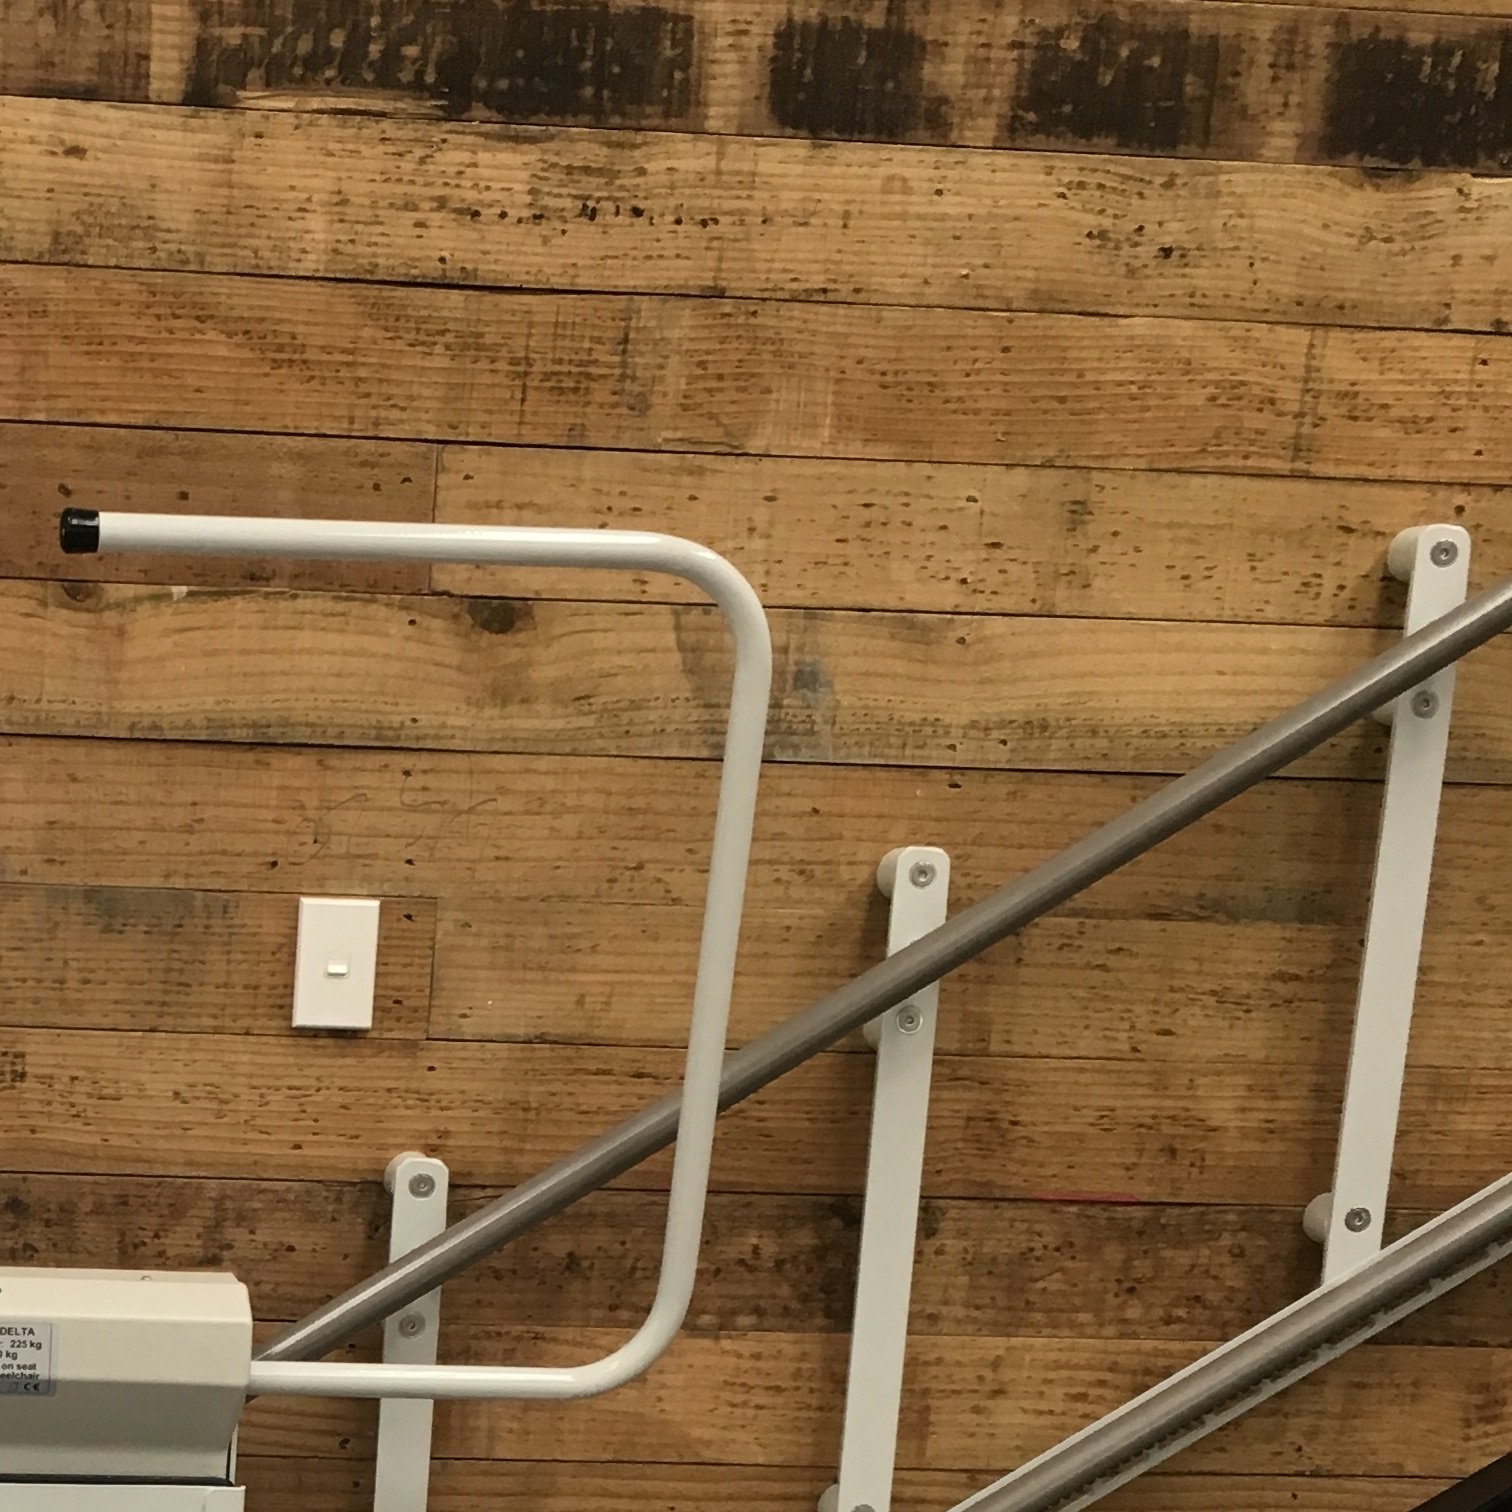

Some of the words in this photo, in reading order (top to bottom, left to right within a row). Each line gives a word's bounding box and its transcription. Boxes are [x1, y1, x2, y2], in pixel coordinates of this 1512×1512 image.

[0, 1326, 36, 1336] DELTA
[9, 1339, 28, 1348] 225
[29, 1340, 42, 1351] kg
[5, 1350, 18, 1360] kg
[16, 1363, 37, 1371] seat
